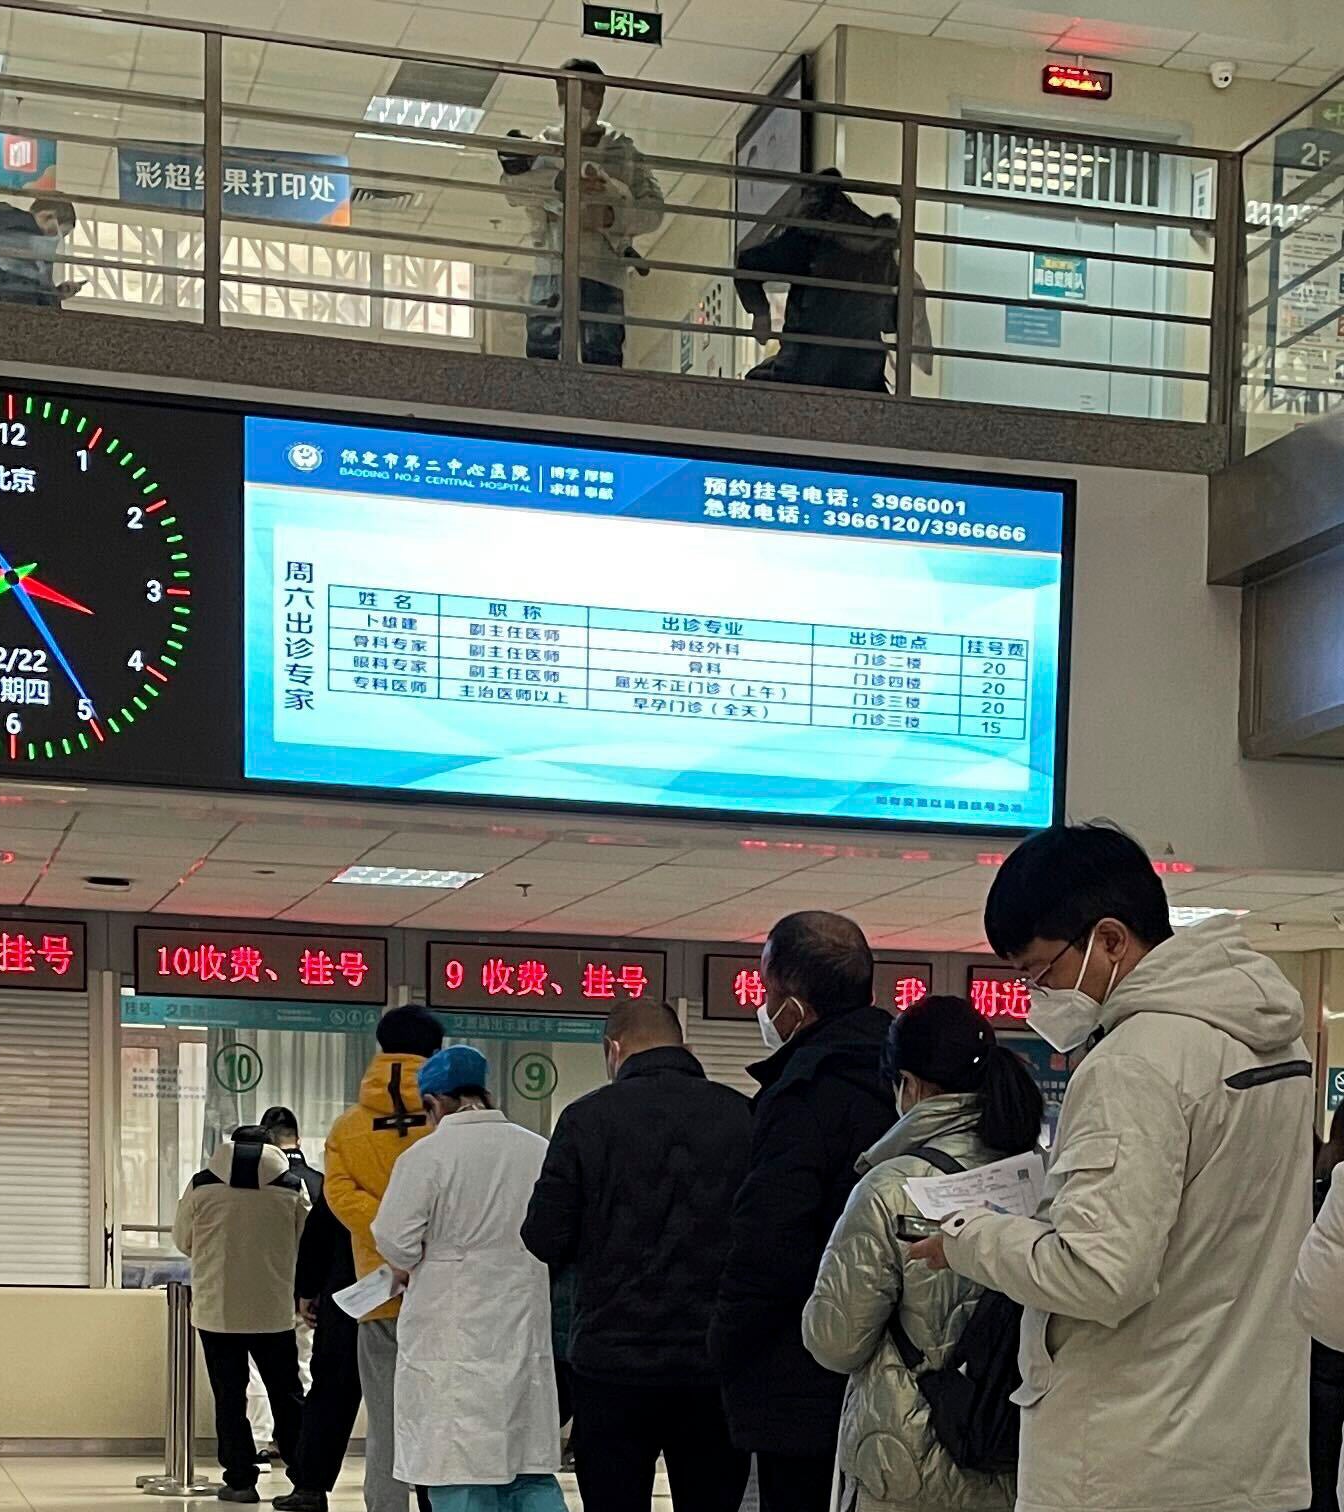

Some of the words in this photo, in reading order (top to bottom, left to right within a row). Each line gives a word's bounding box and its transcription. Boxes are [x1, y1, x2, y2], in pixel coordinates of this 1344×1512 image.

[76, 450, 88, 472] 1
[339, 467, 390, 481] BAODING
[480, 480, 533, 494] HOSPITAL
[127, 507, 144, 530] 2
[146, 580, 162, 603] 3
[284, 560, 315, 713] 周六出诊专家
[469, 623, 561, 643] 副主任医师
[670, 639, 742, 657] 神经外科
[854, 652, 922, 671] 门诊二楼
[982, 662, 1007, 677] 20
[662, 616, 744, 637] 出诊专业
[849, 631, 929, 652] 出诊地点
[967, 638, 1026, 659] 挂号费
[128, 650, 143, 672] 4
[353, 634, 428, 653] 骨科专家
[469, 644, 561, 664] 副主任医师
[687, 660, 722, 676] 骨科
[853, 673, 922, 691] 门诊四楼
[982, 682, 1007, 697] 20
[353, 655, 428, 675] 眼科专家
[469, 664, 561, 684] 副主任医师
[852, 693, 922, 711] 门诊三楼
[981, 702, 1006, 717] 20
[77, 700, 93, 721] 5
[353, 676, 428, 695] 专科医师
[459, 685, 570, 705] 主治医师以上
[852, 713, 922, 731] 门诊三楼
[981, 722, 1002, 736] 15
[5, 713, 21, 735] 6
[444, 959, 464, 989] 9
[733, 969, 767, 1007] 特
[970, 978, 1033, 1018] 附近
[223, 1053, 252, 1085] 10
[524, 1062, 546, 1093] 9
